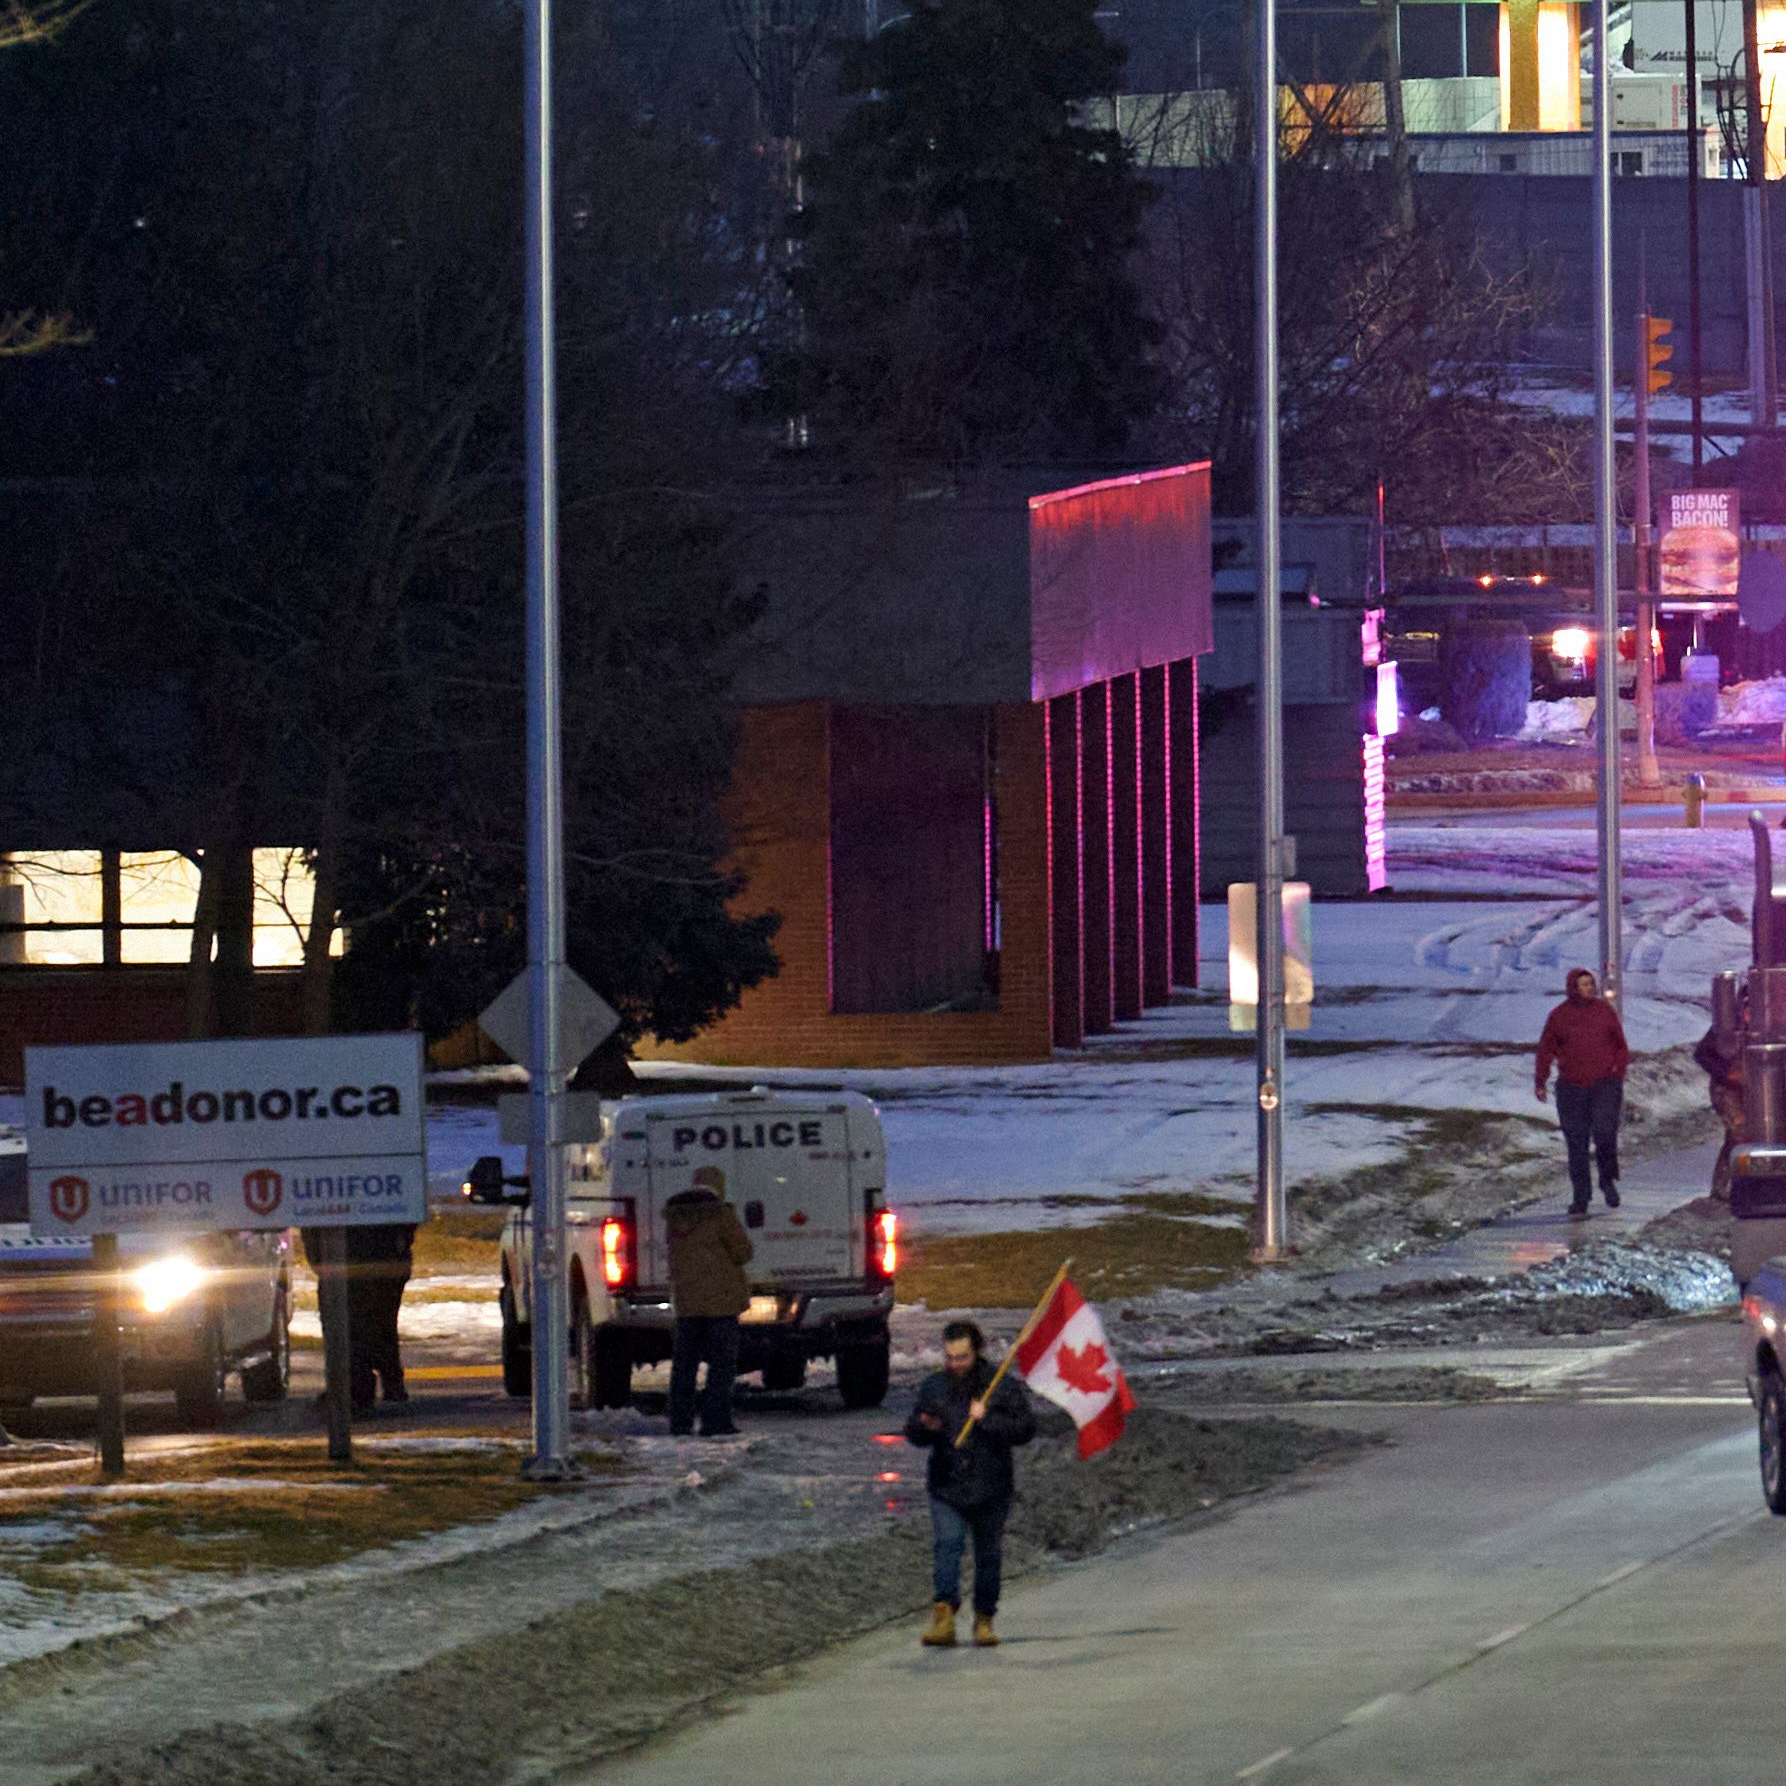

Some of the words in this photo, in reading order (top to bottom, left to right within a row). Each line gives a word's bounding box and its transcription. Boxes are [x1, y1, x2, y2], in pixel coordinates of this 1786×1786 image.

[1672, 495, 1695, 510] BIG
[1698, 494, 1728, 509] MAC
[1672, 511, 1729, 527] BACON!
[42, 1082, 401, 1128] beadonor.ca
[673, 1121, 823, 1152] POLICE
[293, 1174, 402, 1199] UNIFOR
